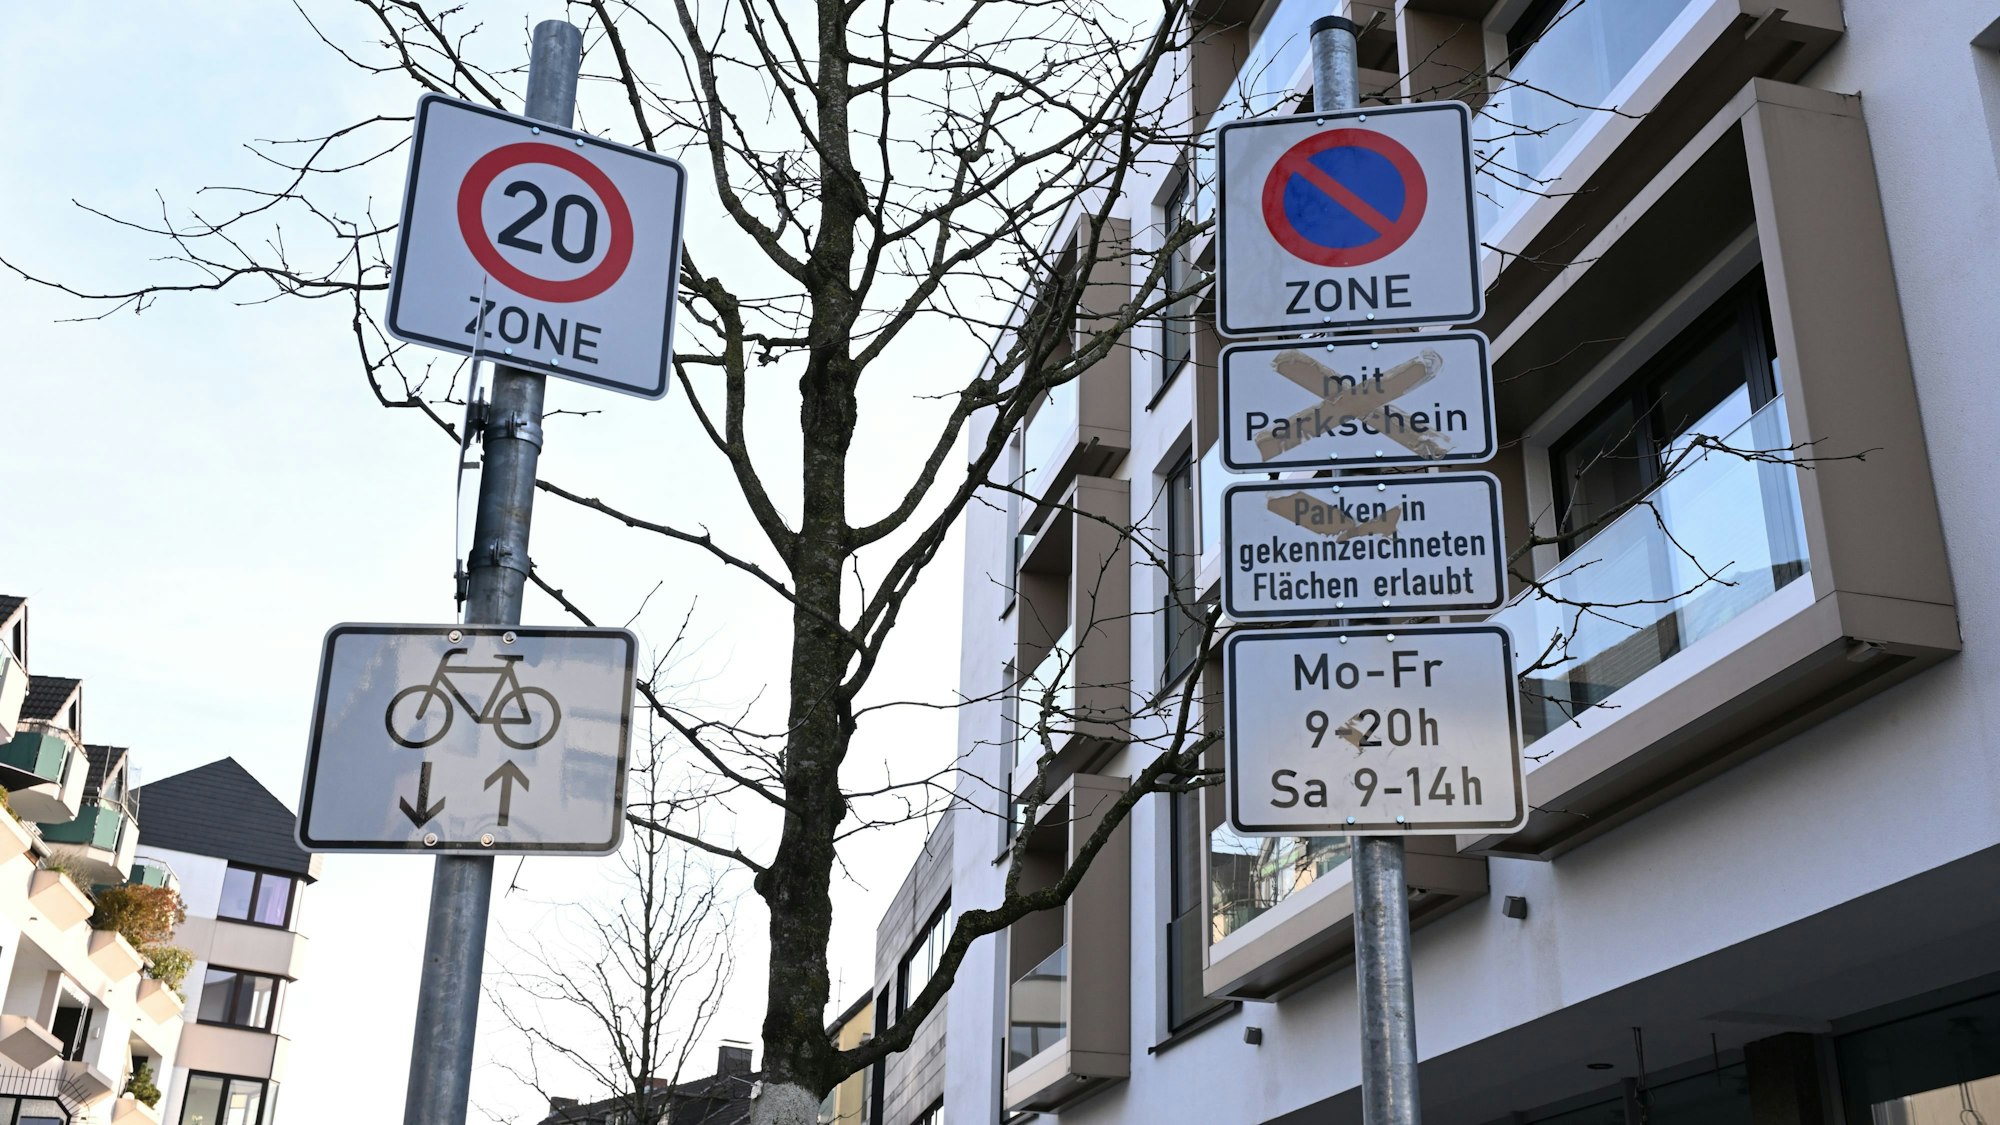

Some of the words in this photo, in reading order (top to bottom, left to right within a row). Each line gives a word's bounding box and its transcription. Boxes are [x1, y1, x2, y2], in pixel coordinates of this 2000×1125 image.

[497, 180, 598, 264] 20
[1285, 274, 1412, 315] ZONE
[464, 295, 602, 364] ZONE
[1323, 366, 1384, 397] mit
[1246, 402, 1468, 441] Parkschein
[1294, 496, 1387, 526] Parken
[1401, 494, 1425, 522] in
[1239, 530, 1486, 572] gekennzeichneten
[1253, 570, 1358, 601] Flächen
[1374, 566, 1474, 597] erlaubt
[1293, 650, 1443, 691] Mo-Fr
[1305, 707, 1439, 748] 9-20h
[1270, 769, 1328, 809] Sa
[1354, 766, 1483, 807] 9-14h
